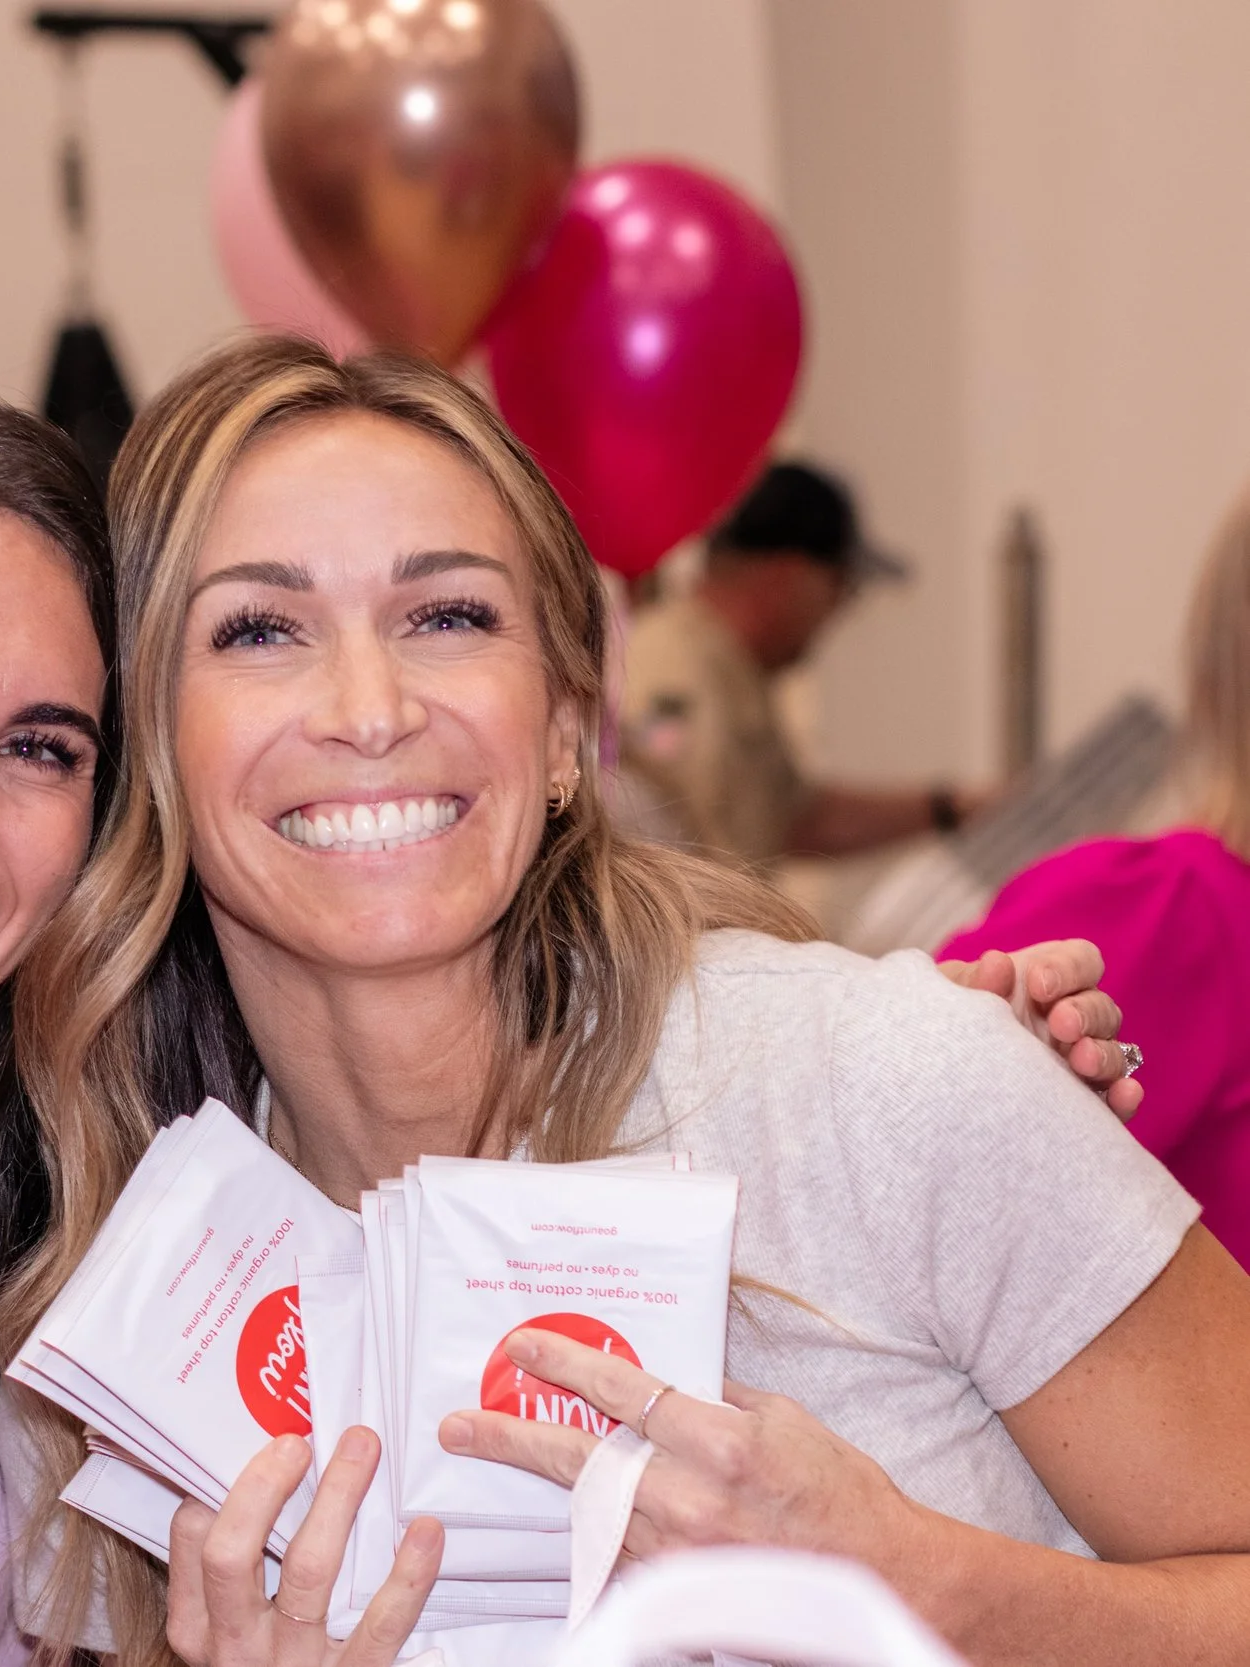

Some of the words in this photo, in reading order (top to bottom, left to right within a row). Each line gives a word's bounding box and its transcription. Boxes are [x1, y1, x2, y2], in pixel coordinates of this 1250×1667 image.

[268, 1218, 295, 1248] 100%
[530, 1222, 618, 1236] goauntflow.com
[242, 1235, 254, 1249] no
[166, 1226, 215, 1297] goauntflow.com
[227, 1249, 244, 1273] dyes
[240, 1247, 270, 1287] organic
[506, 1258, 563, 1273] perfumes
[567, 1264, 582, 1273] no
[592, 1264, 620, 1278] dyes
[623, 1268, 639, 1277] no
[214, 1278, 227, 1292] no
[466, 1278, 504, 1292] sheet
[509, 1279, 532, 1294] top
[536, 1283, 582, 1297] cotton
[587, 1286, 639, 1300] organic
[643, 1291, 678, 1305] 100%
[181, 1291, 217, 1340] perfumes
[215, 1290, 242, 1328] cotton
[200, 1329, 218, 1350] top
[177, 1350, 202, 1384] sheet
